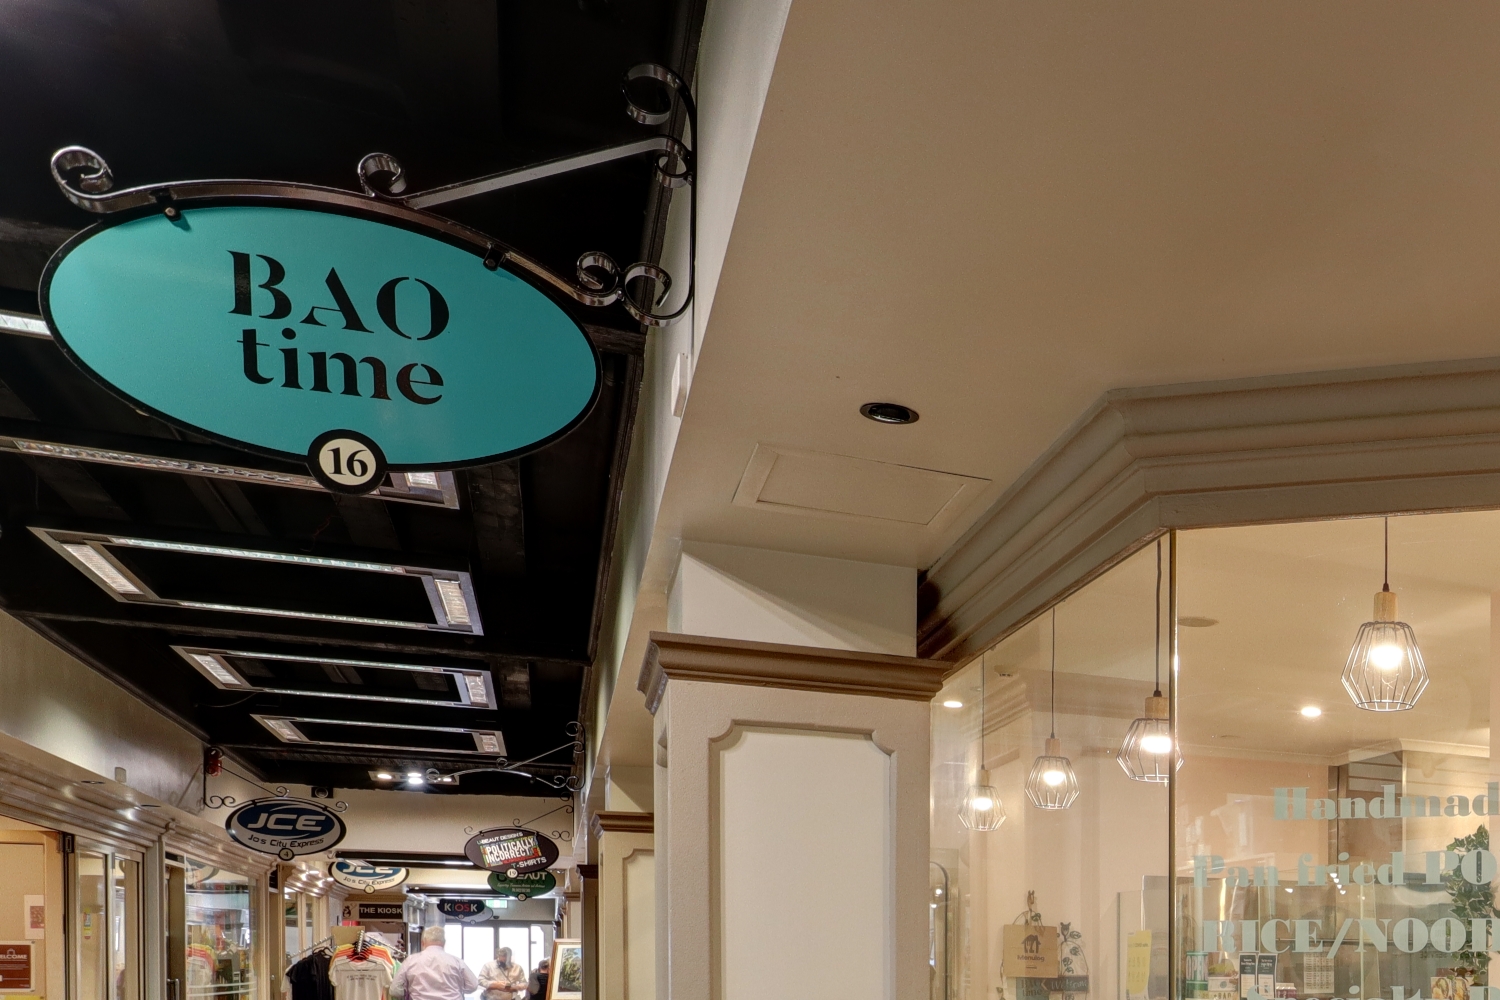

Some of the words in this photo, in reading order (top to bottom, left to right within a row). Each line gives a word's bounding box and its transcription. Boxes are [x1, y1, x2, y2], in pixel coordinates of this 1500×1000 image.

[227, 249, 450, 341] BAO
[237, 327, 445, 406] time
[327, 447, 370, 479] 16
[247, 812, 327, 832] JCE
[269, 838, 288, 849] City
[289, 837, 325, 849] Express
[485, 837, 535, 855] POLITICALLY
[485, 847, 531, 864] INCORRECT
[511, 856, 548, 869] T-SHIRTS
[1192, 852, 1291, 890] Pan
[1296, 852, 1406, 887] fried
[443, 902, 478, 912] KIOSK
[1017, 955, 1045, 963] Menulog
